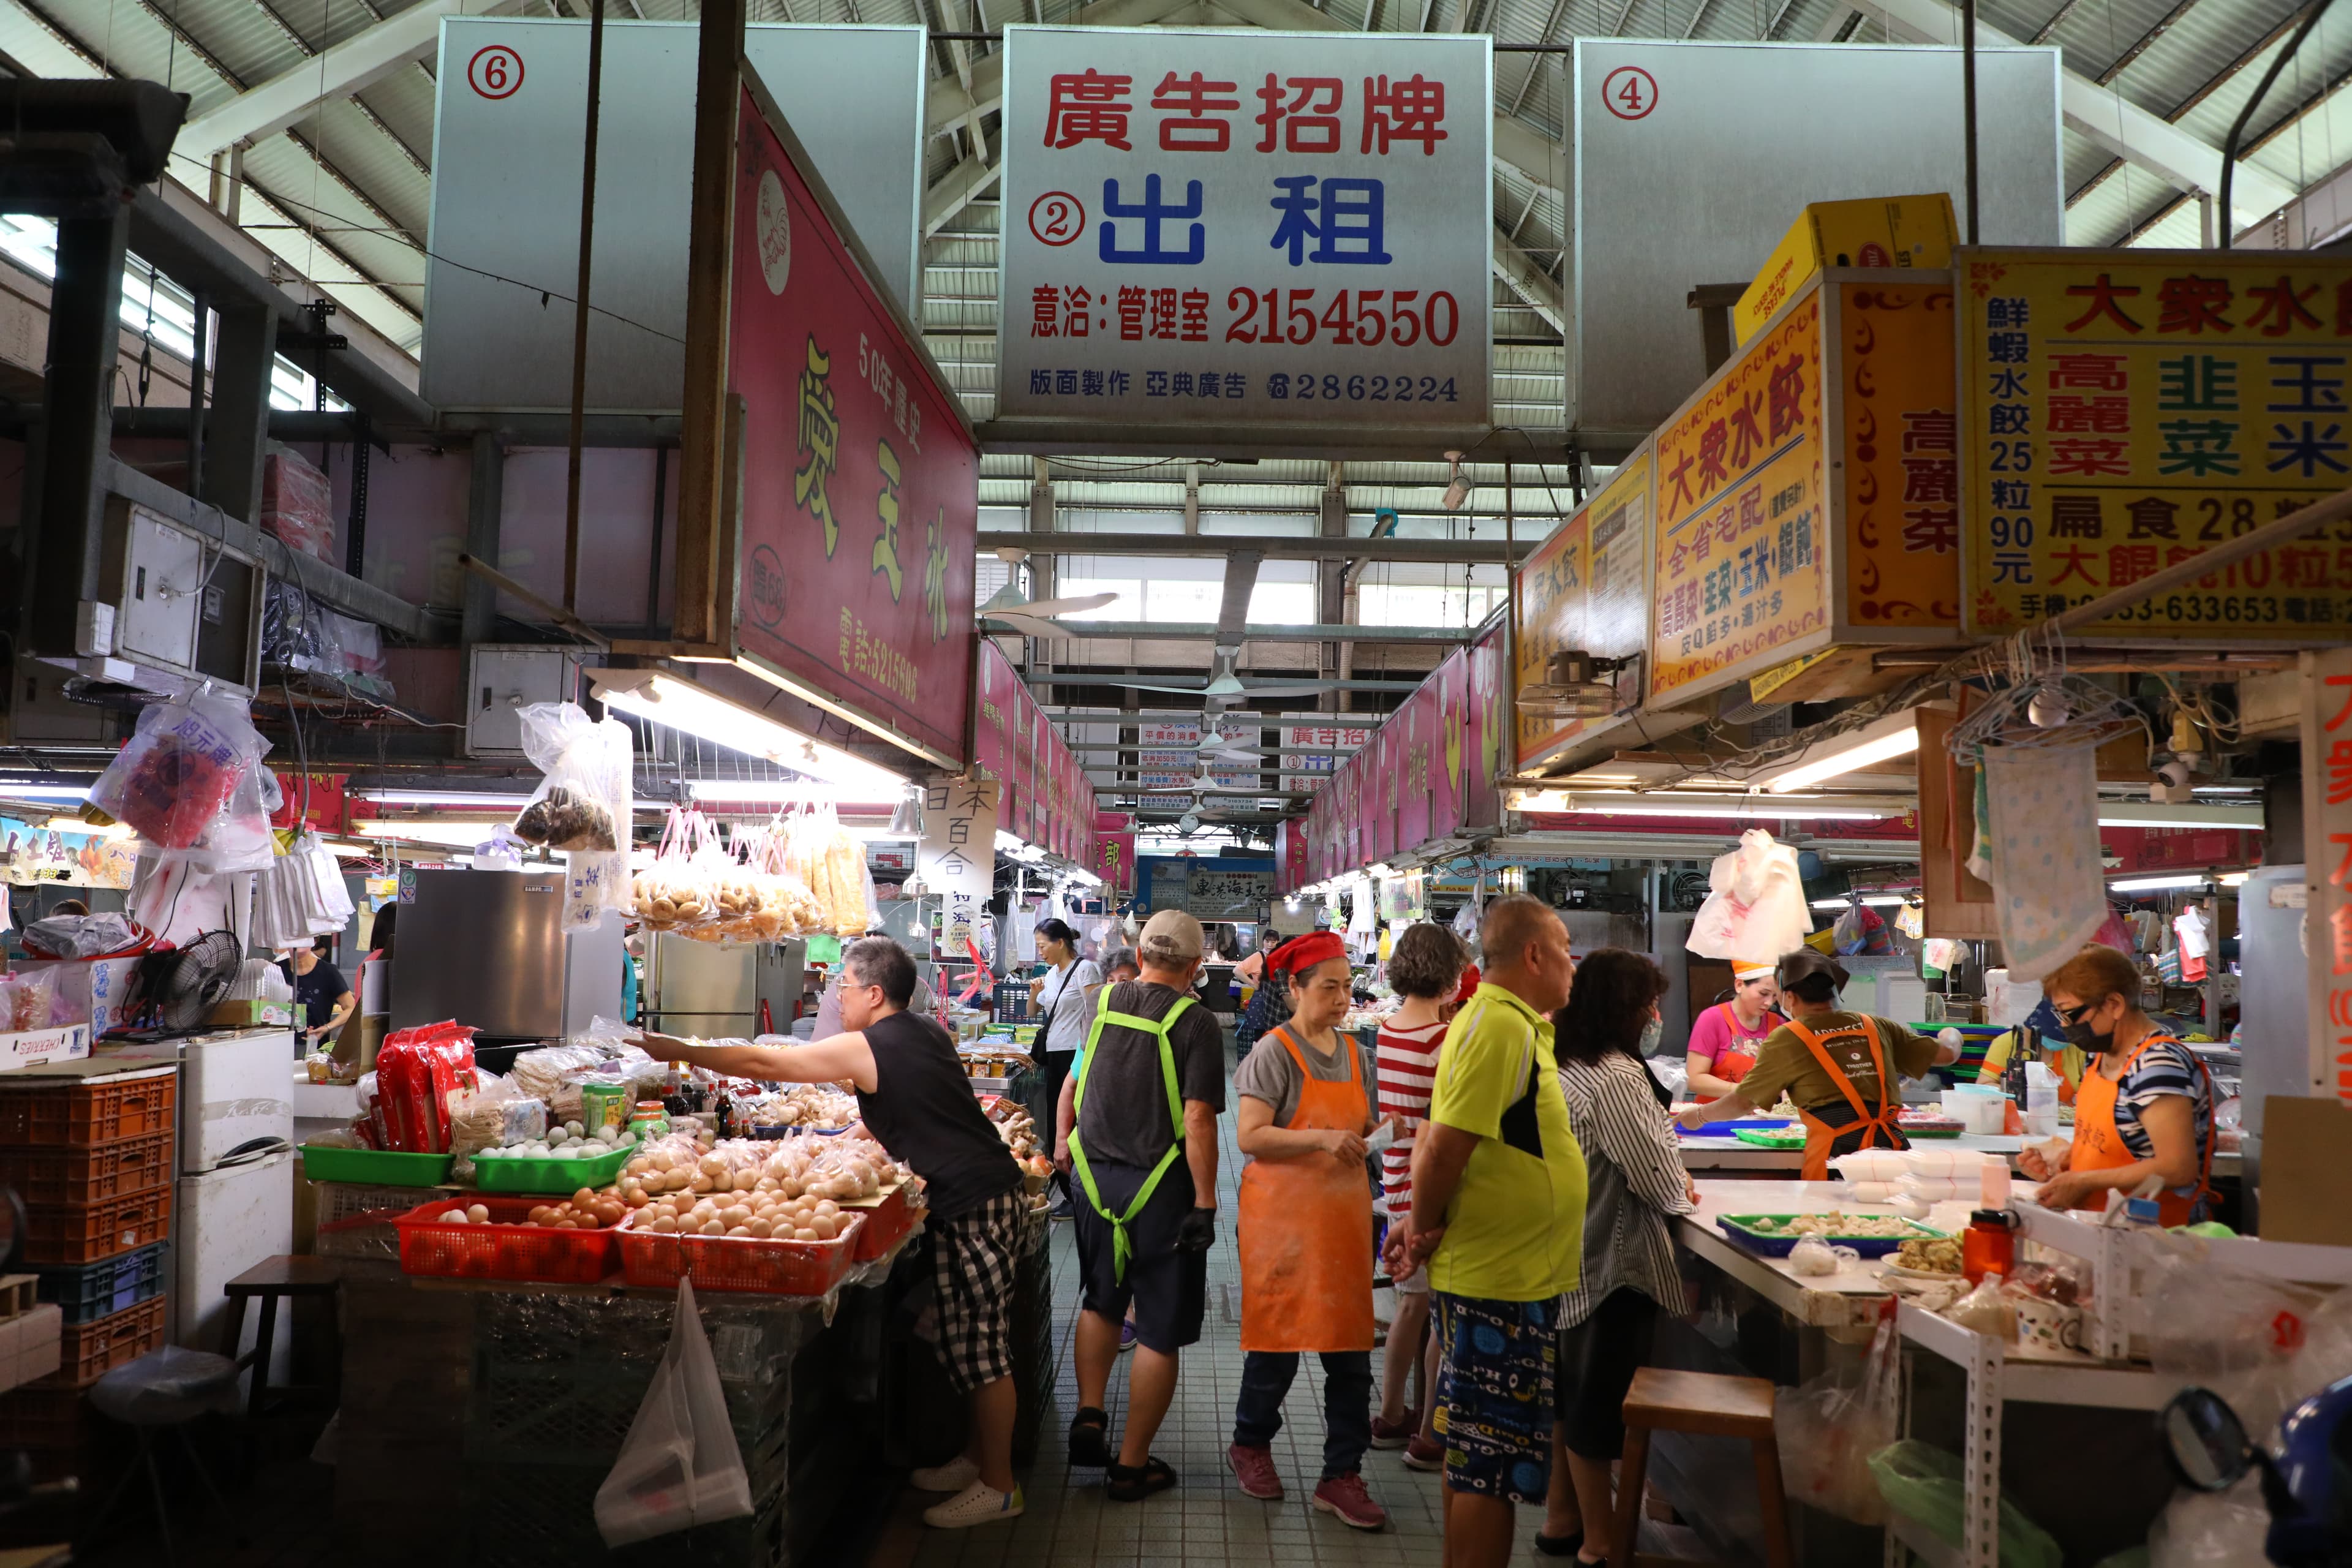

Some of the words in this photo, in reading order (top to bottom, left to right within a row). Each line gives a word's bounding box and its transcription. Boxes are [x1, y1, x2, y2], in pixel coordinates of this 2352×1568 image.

[1044, 67, 1448, 156] 廣告招牌
[1099, 173, 1393, 266] 出租
[1226, 286, 1460, 347] 2154550
[1030, 369, 1130, 397] 版面製作
[1147, 371, 1247, 399] 亞典廣告
[1296, 375, 1458, 402] 2862224
[2046, 353, 2132, 477] 高麗菜
[2158, 355, 2242, 477] 韭菜
[2266, 356, 2351, 478] 玉米
[1668, 483, 1766, 579] 全省宅配
[927, 785, 992, 817] 日本
[935, 818, 974, 876] 百合
[19, 1038, 61, 1055] CHERRIES
